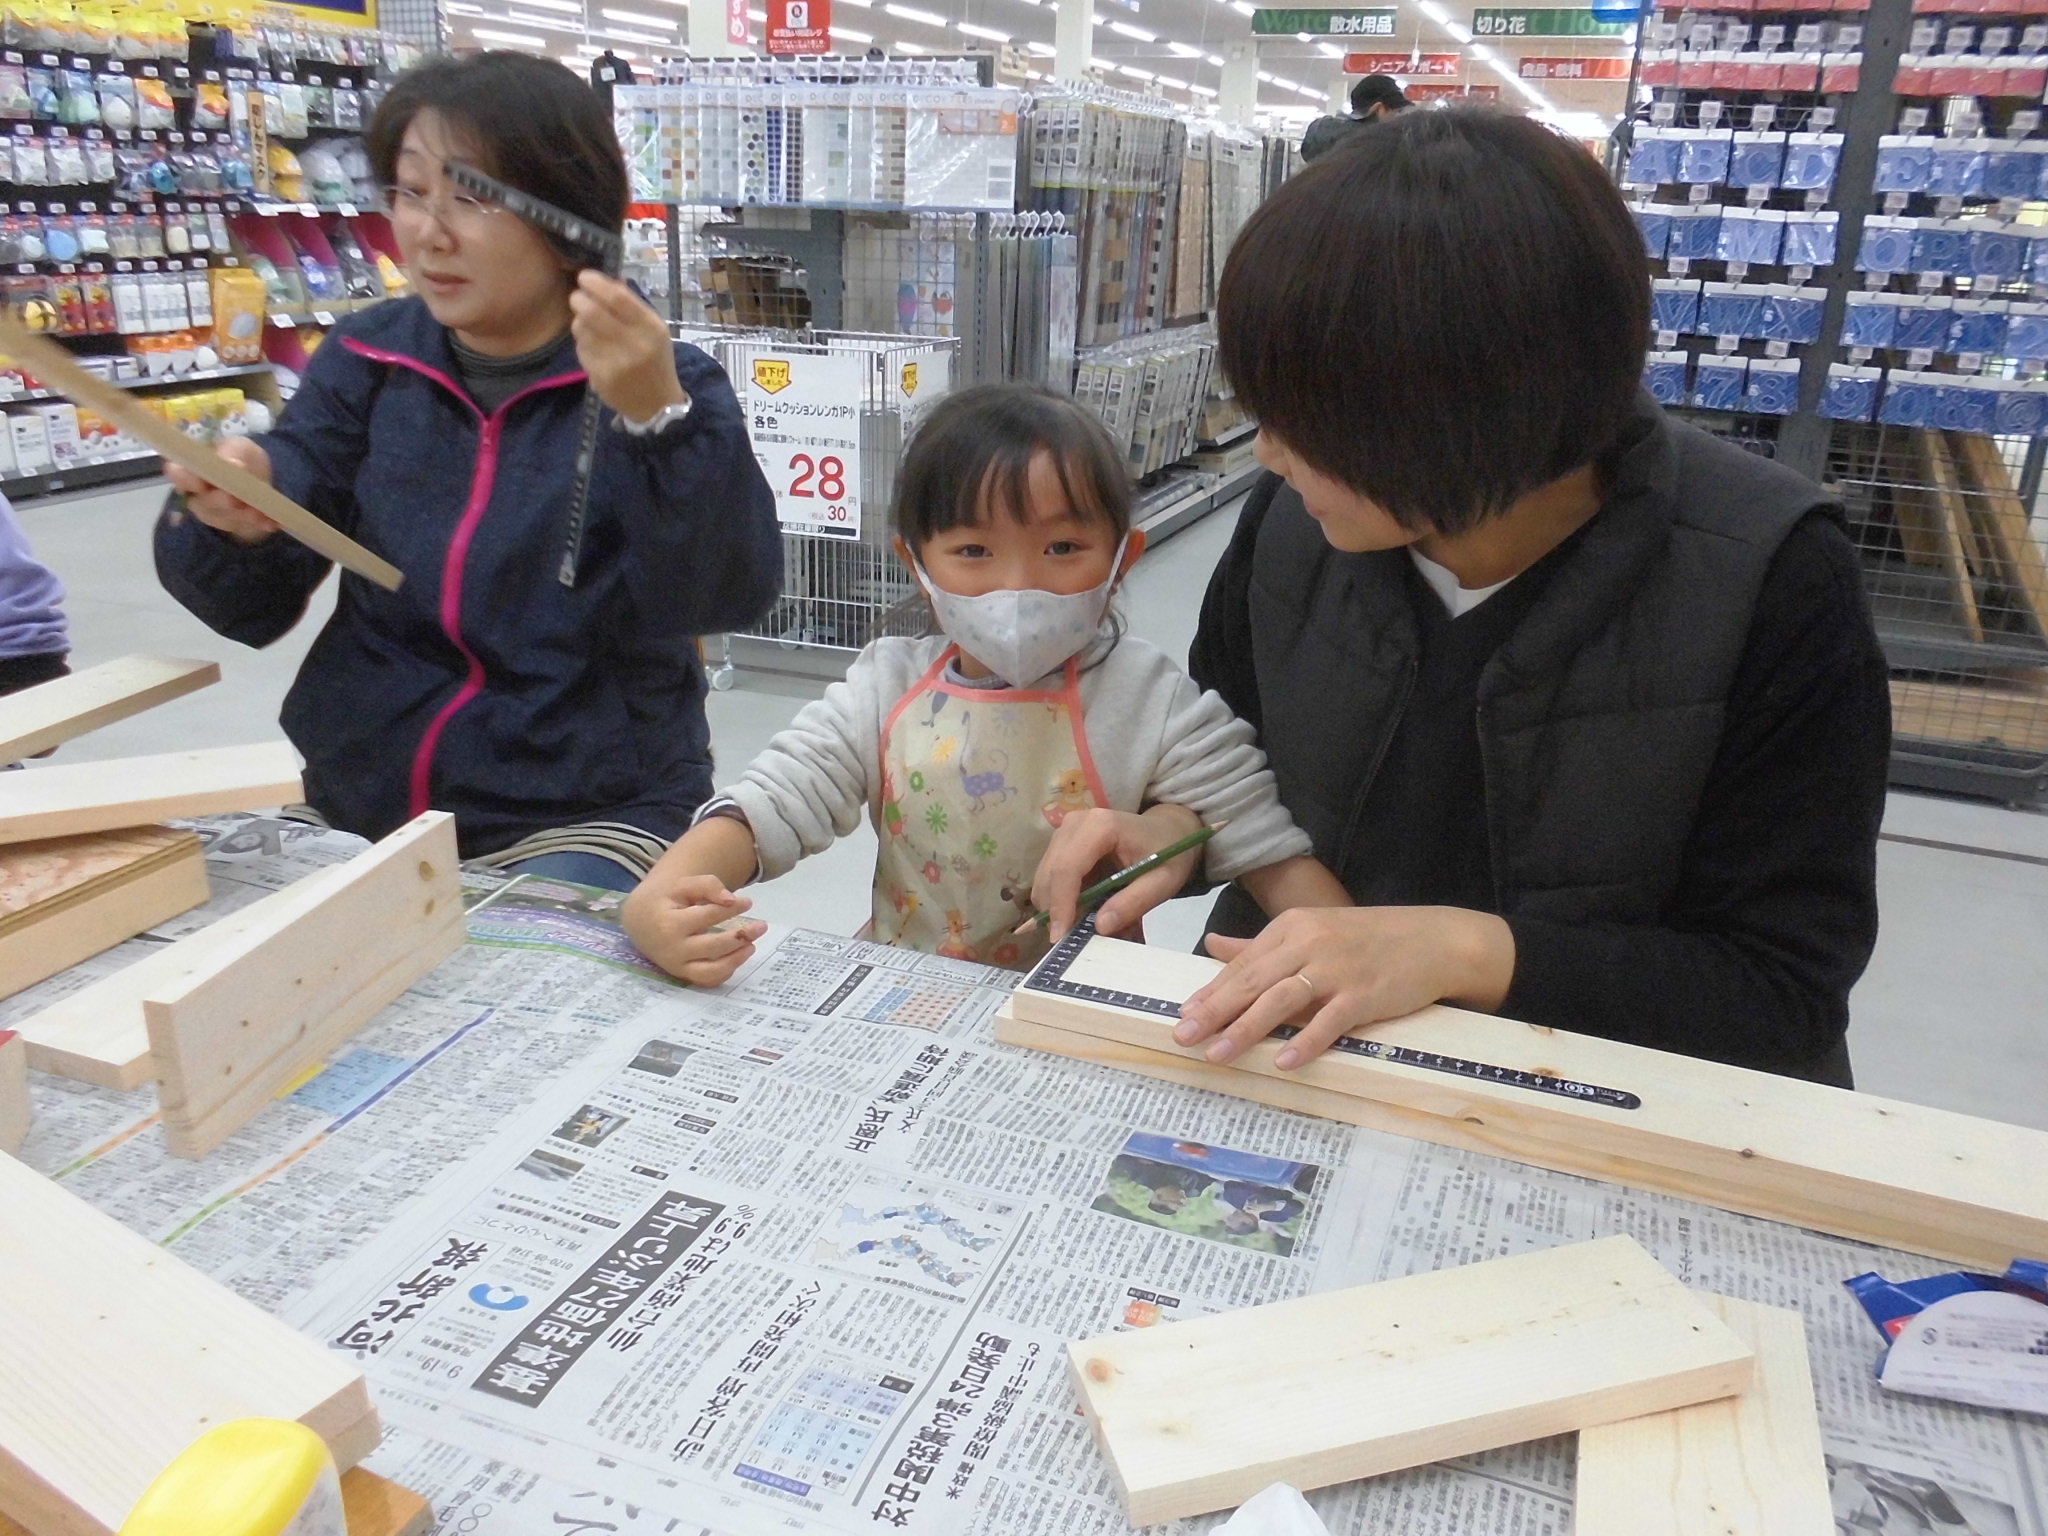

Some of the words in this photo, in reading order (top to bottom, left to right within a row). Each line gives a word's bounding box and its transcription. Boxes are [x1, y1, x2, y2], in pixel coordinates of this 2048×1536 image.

[1330, 15, 1393, 33] 散水用品
[1477, 16, 1526, 34] 切り花
[1370, 60, 1457, 73] シニアサポート
[1731, 145, 1778, 186] C
[1655, 295, 1697, 330] V
[1767, 297, 1818, 340] X
[757, 367, 786, 378] 値下げ
[1701, 369, 1739, 408] 7
[1753, 373, 1787, 412] 8
[755, 416, 778, 429] 各色
[789, 453, 845, 501] 28
[848, 497, 857, 506] 円
[828, 505, 847, 522] 30
[843, 1045, 950, 1153] 正恩氏、米朝進展に期待
[475, 1214, 582, 1252] 再生へ心ひとつに
[330, 1238, 490, 1361] 河北新報
[489, 1198, 714, 1397] 基準地価27年ぶり上昇
[606, 1204, 758, 1353] 仙台商業地は9.9%
[672, 1376, 748, 1463] 訪日客増
[739, 1279, 821, 1376] 再開発相次ぐ
[872, 1398, 972, 1528] 対中関税第3弾
[950, 1332, 1012, 1397] 24日発動
[945, 1461, 975, 1501] 米政権
[963, 1342, 1041, 1461] 閣僚級協議中止も
